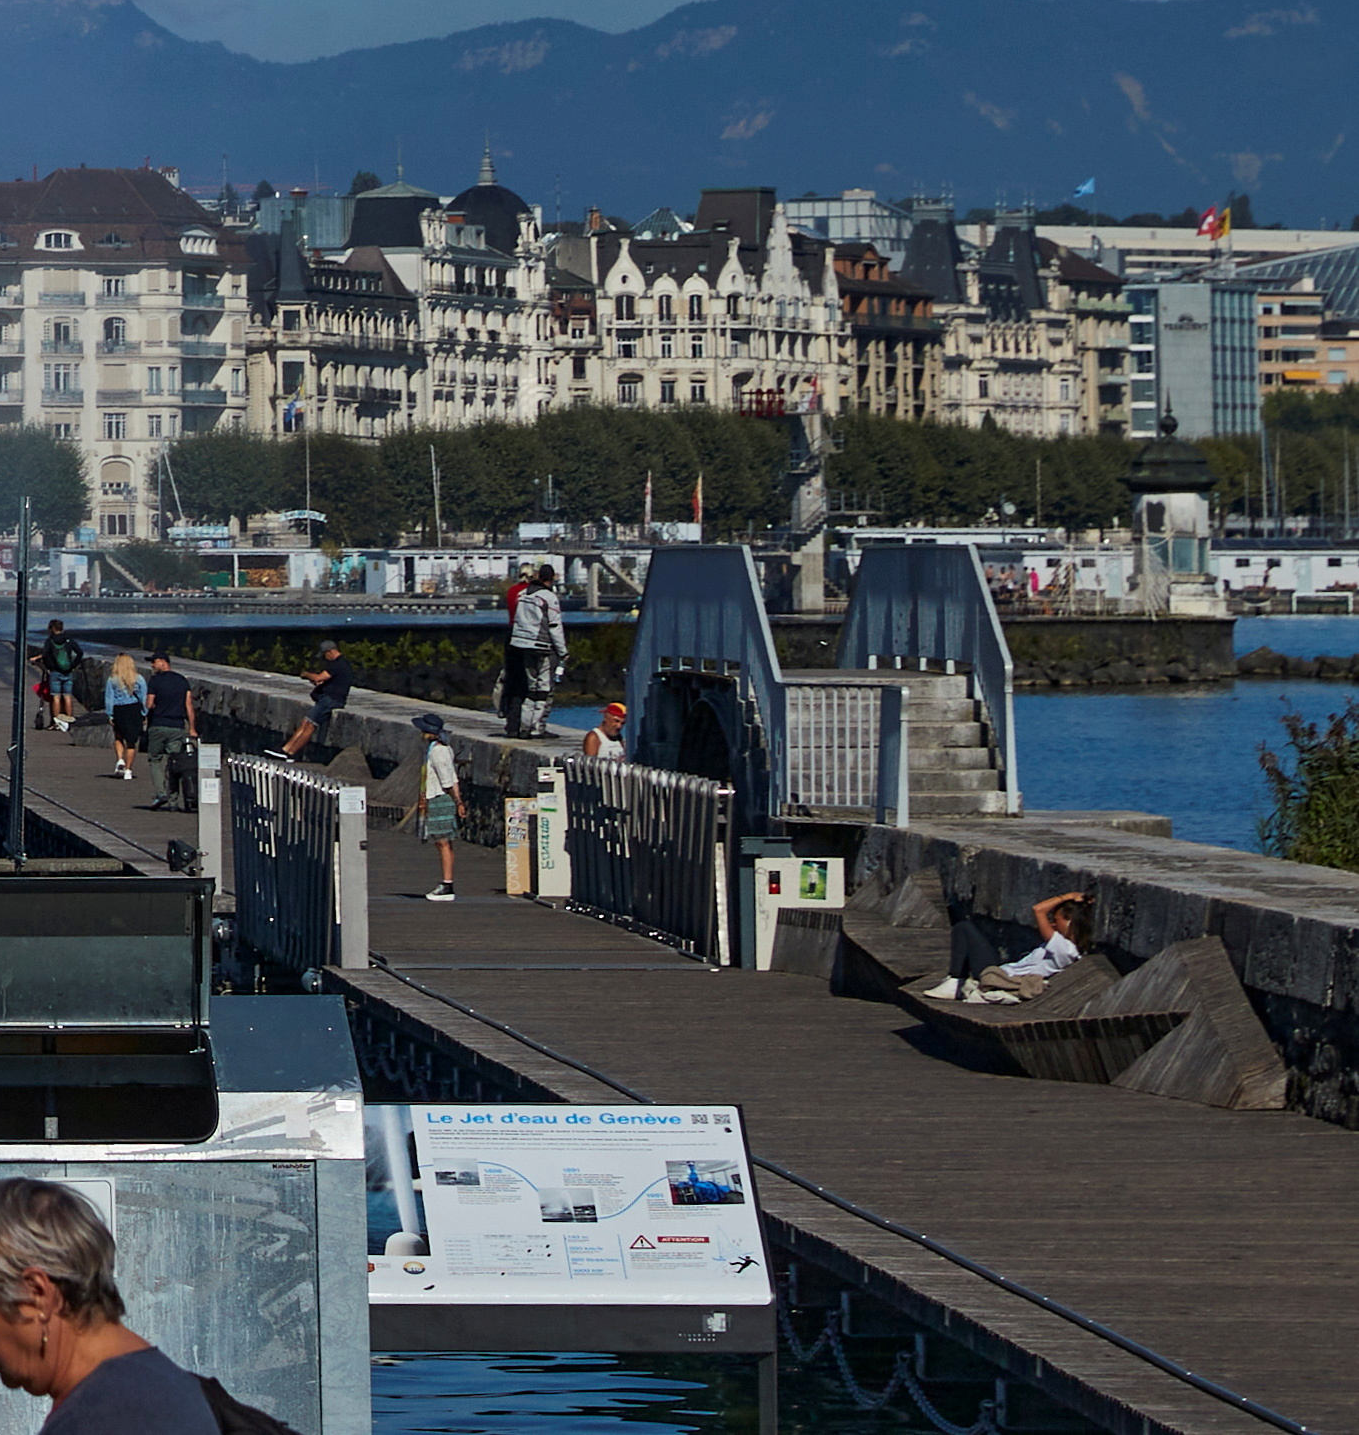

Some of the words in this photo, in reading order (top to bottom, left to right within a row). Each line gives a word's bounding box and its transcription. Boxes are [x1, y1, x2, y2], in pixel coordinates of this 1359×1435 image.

[427, 1112, 453, 1124] Le
[460, 1112, 494, 1124] Jet
[501, 1112, 558, 1124] d'eau
[565, 1112, 592, 1124] de
[599, 1112, 682, 1125] Genève
